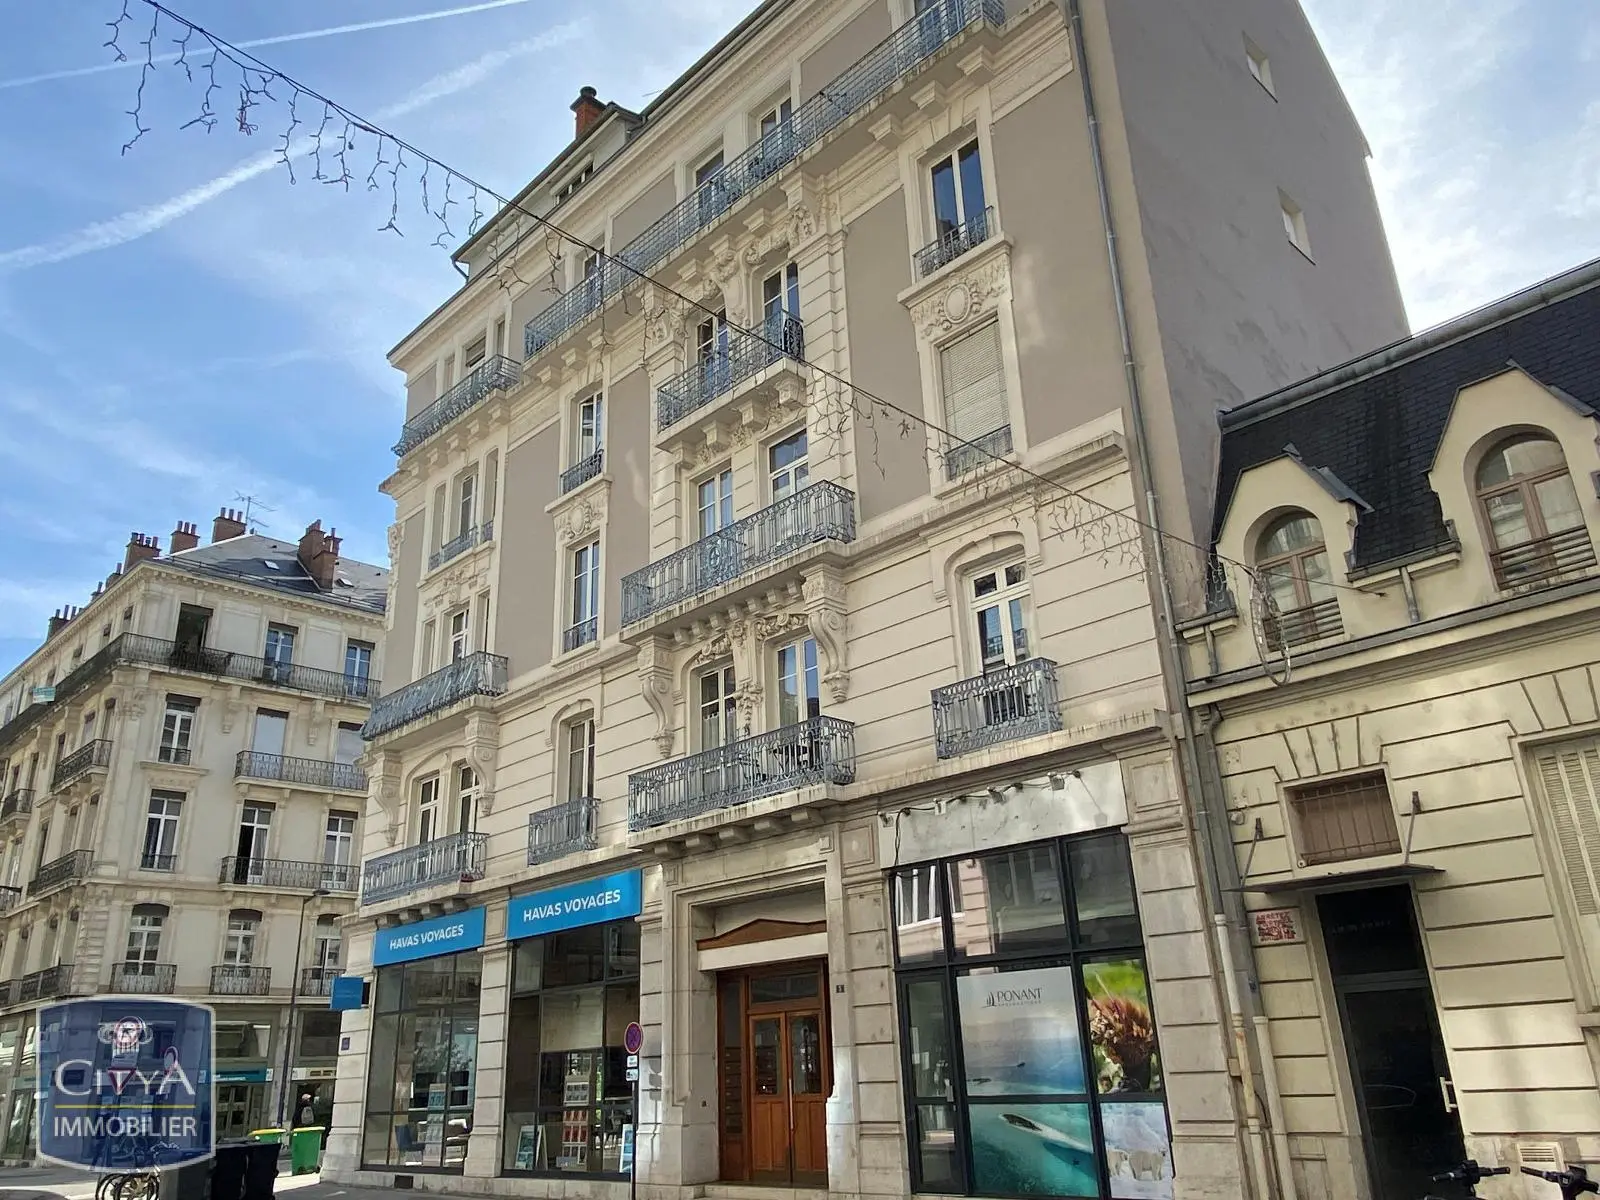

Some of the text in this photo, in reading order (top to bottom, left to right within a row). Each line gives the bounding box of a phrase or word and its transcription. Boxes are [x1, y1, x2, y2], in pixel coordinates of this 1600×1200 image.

[523, 889, 621, 922] HAVAS VOYAGES
[389, 923, 464, 951] HAVAS VOYAGES
[997, 987, 1042, 1003] PONANT
